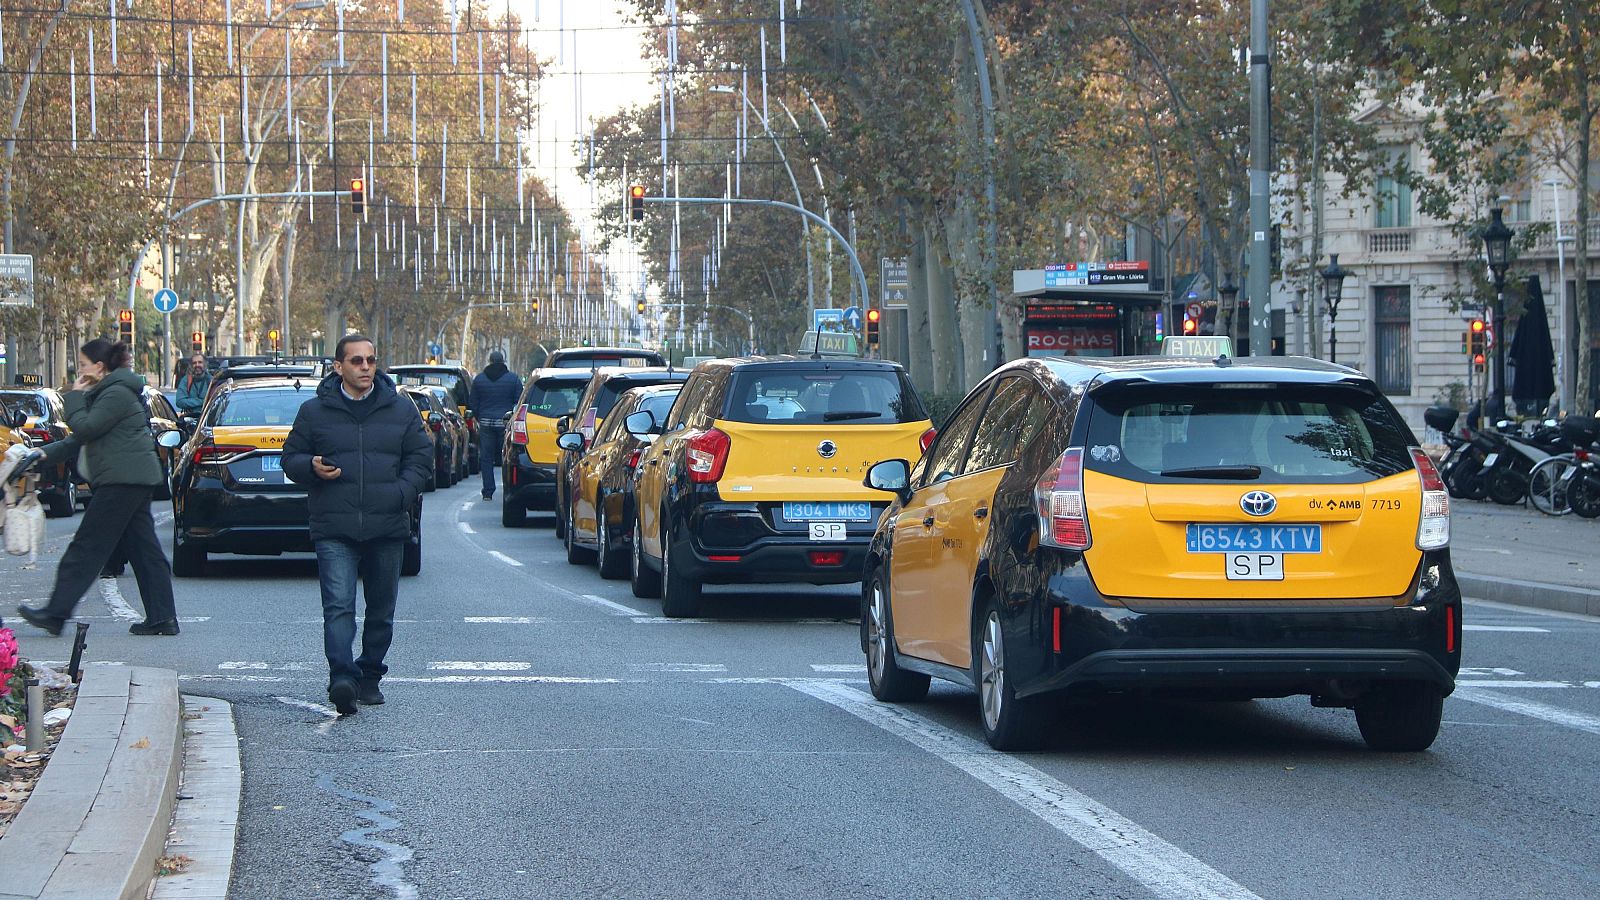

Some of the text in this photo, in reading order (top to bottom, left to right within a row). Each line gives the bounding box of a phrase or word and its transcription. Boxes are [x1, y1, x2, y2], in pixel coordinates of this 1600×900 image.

[822, 337, 845, 350] TAXI
[1028, 334, 1113, 347] ROCHAS
[1186, 340, 1217, 356] TAXI
[22, 375, 37, 384] TAXI
[1330, 447, 1352, 457] taxi
[793, 503, 867, 516] 3041 MKS
[1309, 498, 1401, 510] dv. AMB 7719
[814, 525, 841, 538] SP
[1201, 527, 1316, 549] 6543 KTV
[1233, 554, 1275, 576] SP
